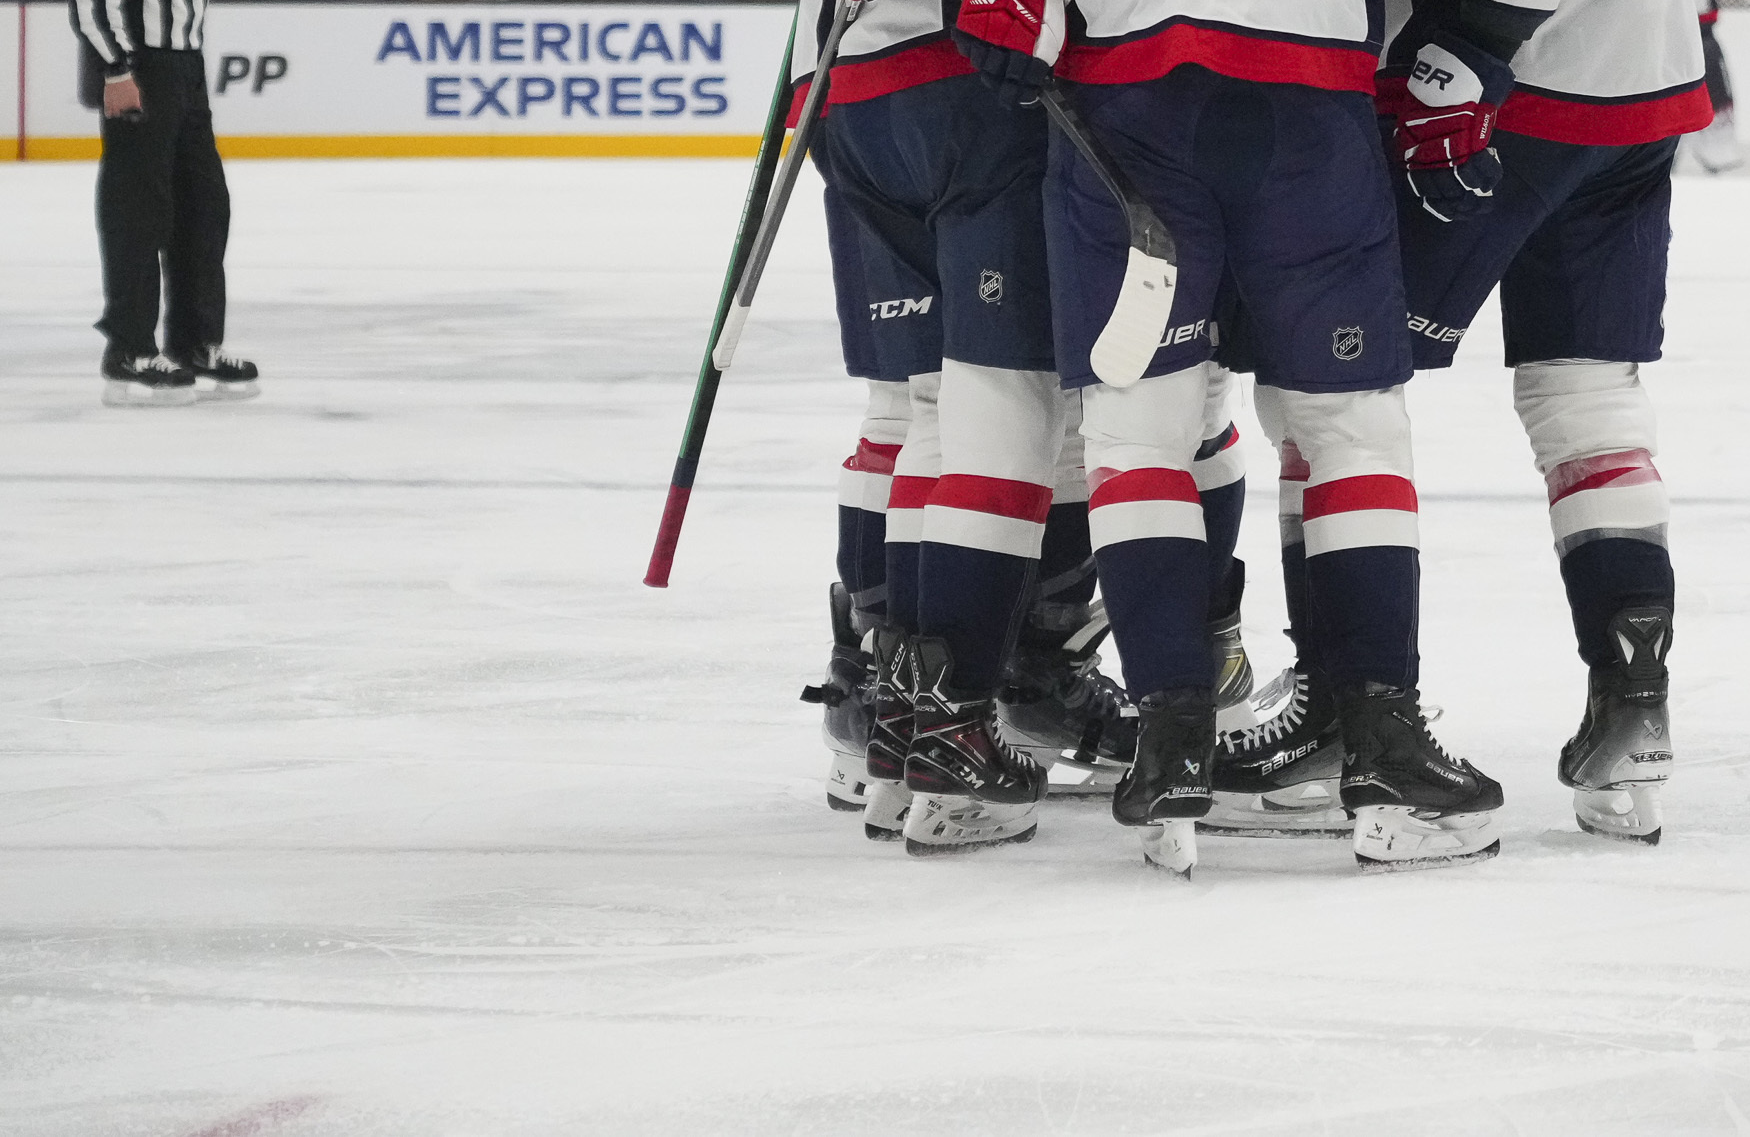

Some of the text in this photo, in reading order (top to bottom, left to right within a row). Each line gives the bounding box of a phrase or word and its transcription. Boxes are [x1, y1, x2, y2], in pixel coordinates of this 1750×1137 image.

[375, 21, 724, 63] AMERICAN
[426, 75, 729, 118] EXPRESS
[1479, 113, 1491, 140] WILSON
[1158, 319, 1206, 348] UER
[1407, 311, 1467, 344] AUER
[1261, 739, 1318, 777] BAUER
[1426, 761, 1465, 785] BAUER
[1172, 785, 1208, 795] BAUER
